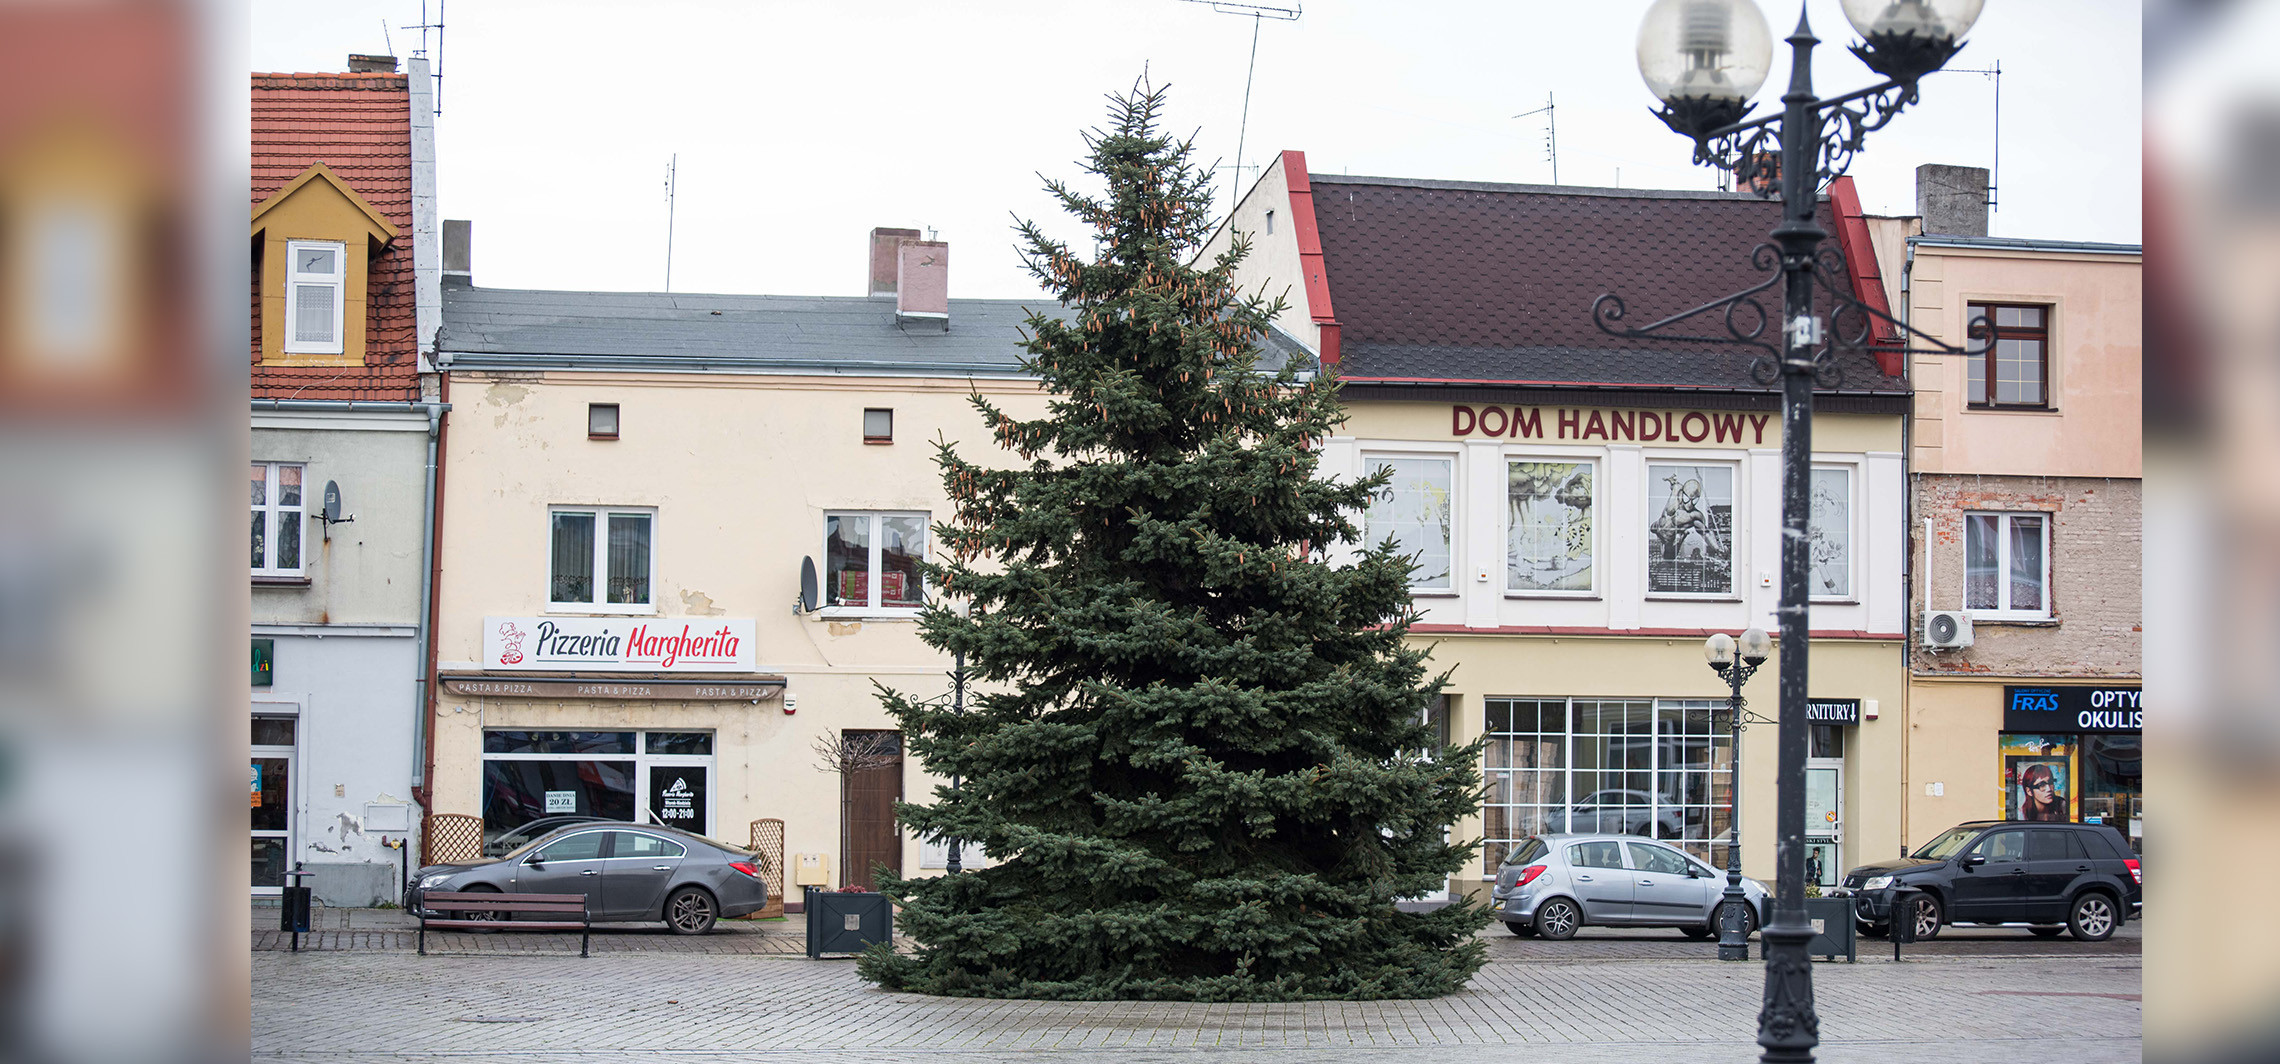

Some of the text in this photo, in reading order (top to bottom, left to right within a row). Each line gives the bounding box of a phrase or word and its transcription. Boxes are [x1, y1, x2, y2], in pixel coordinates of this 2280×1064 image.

[1453, 405, 1770, 444] DOM HANDLOWY
[536, 620, 739, 668] Pizzeria Margherita
[459, 683, 532, 693] PASTA & PIZZA
[578, 685, 650, 695] PASTA & PIZZA
[695, 687, 768, 697] PASTA & PIZZA
[2091, 690, 2142, 708] OPTY
